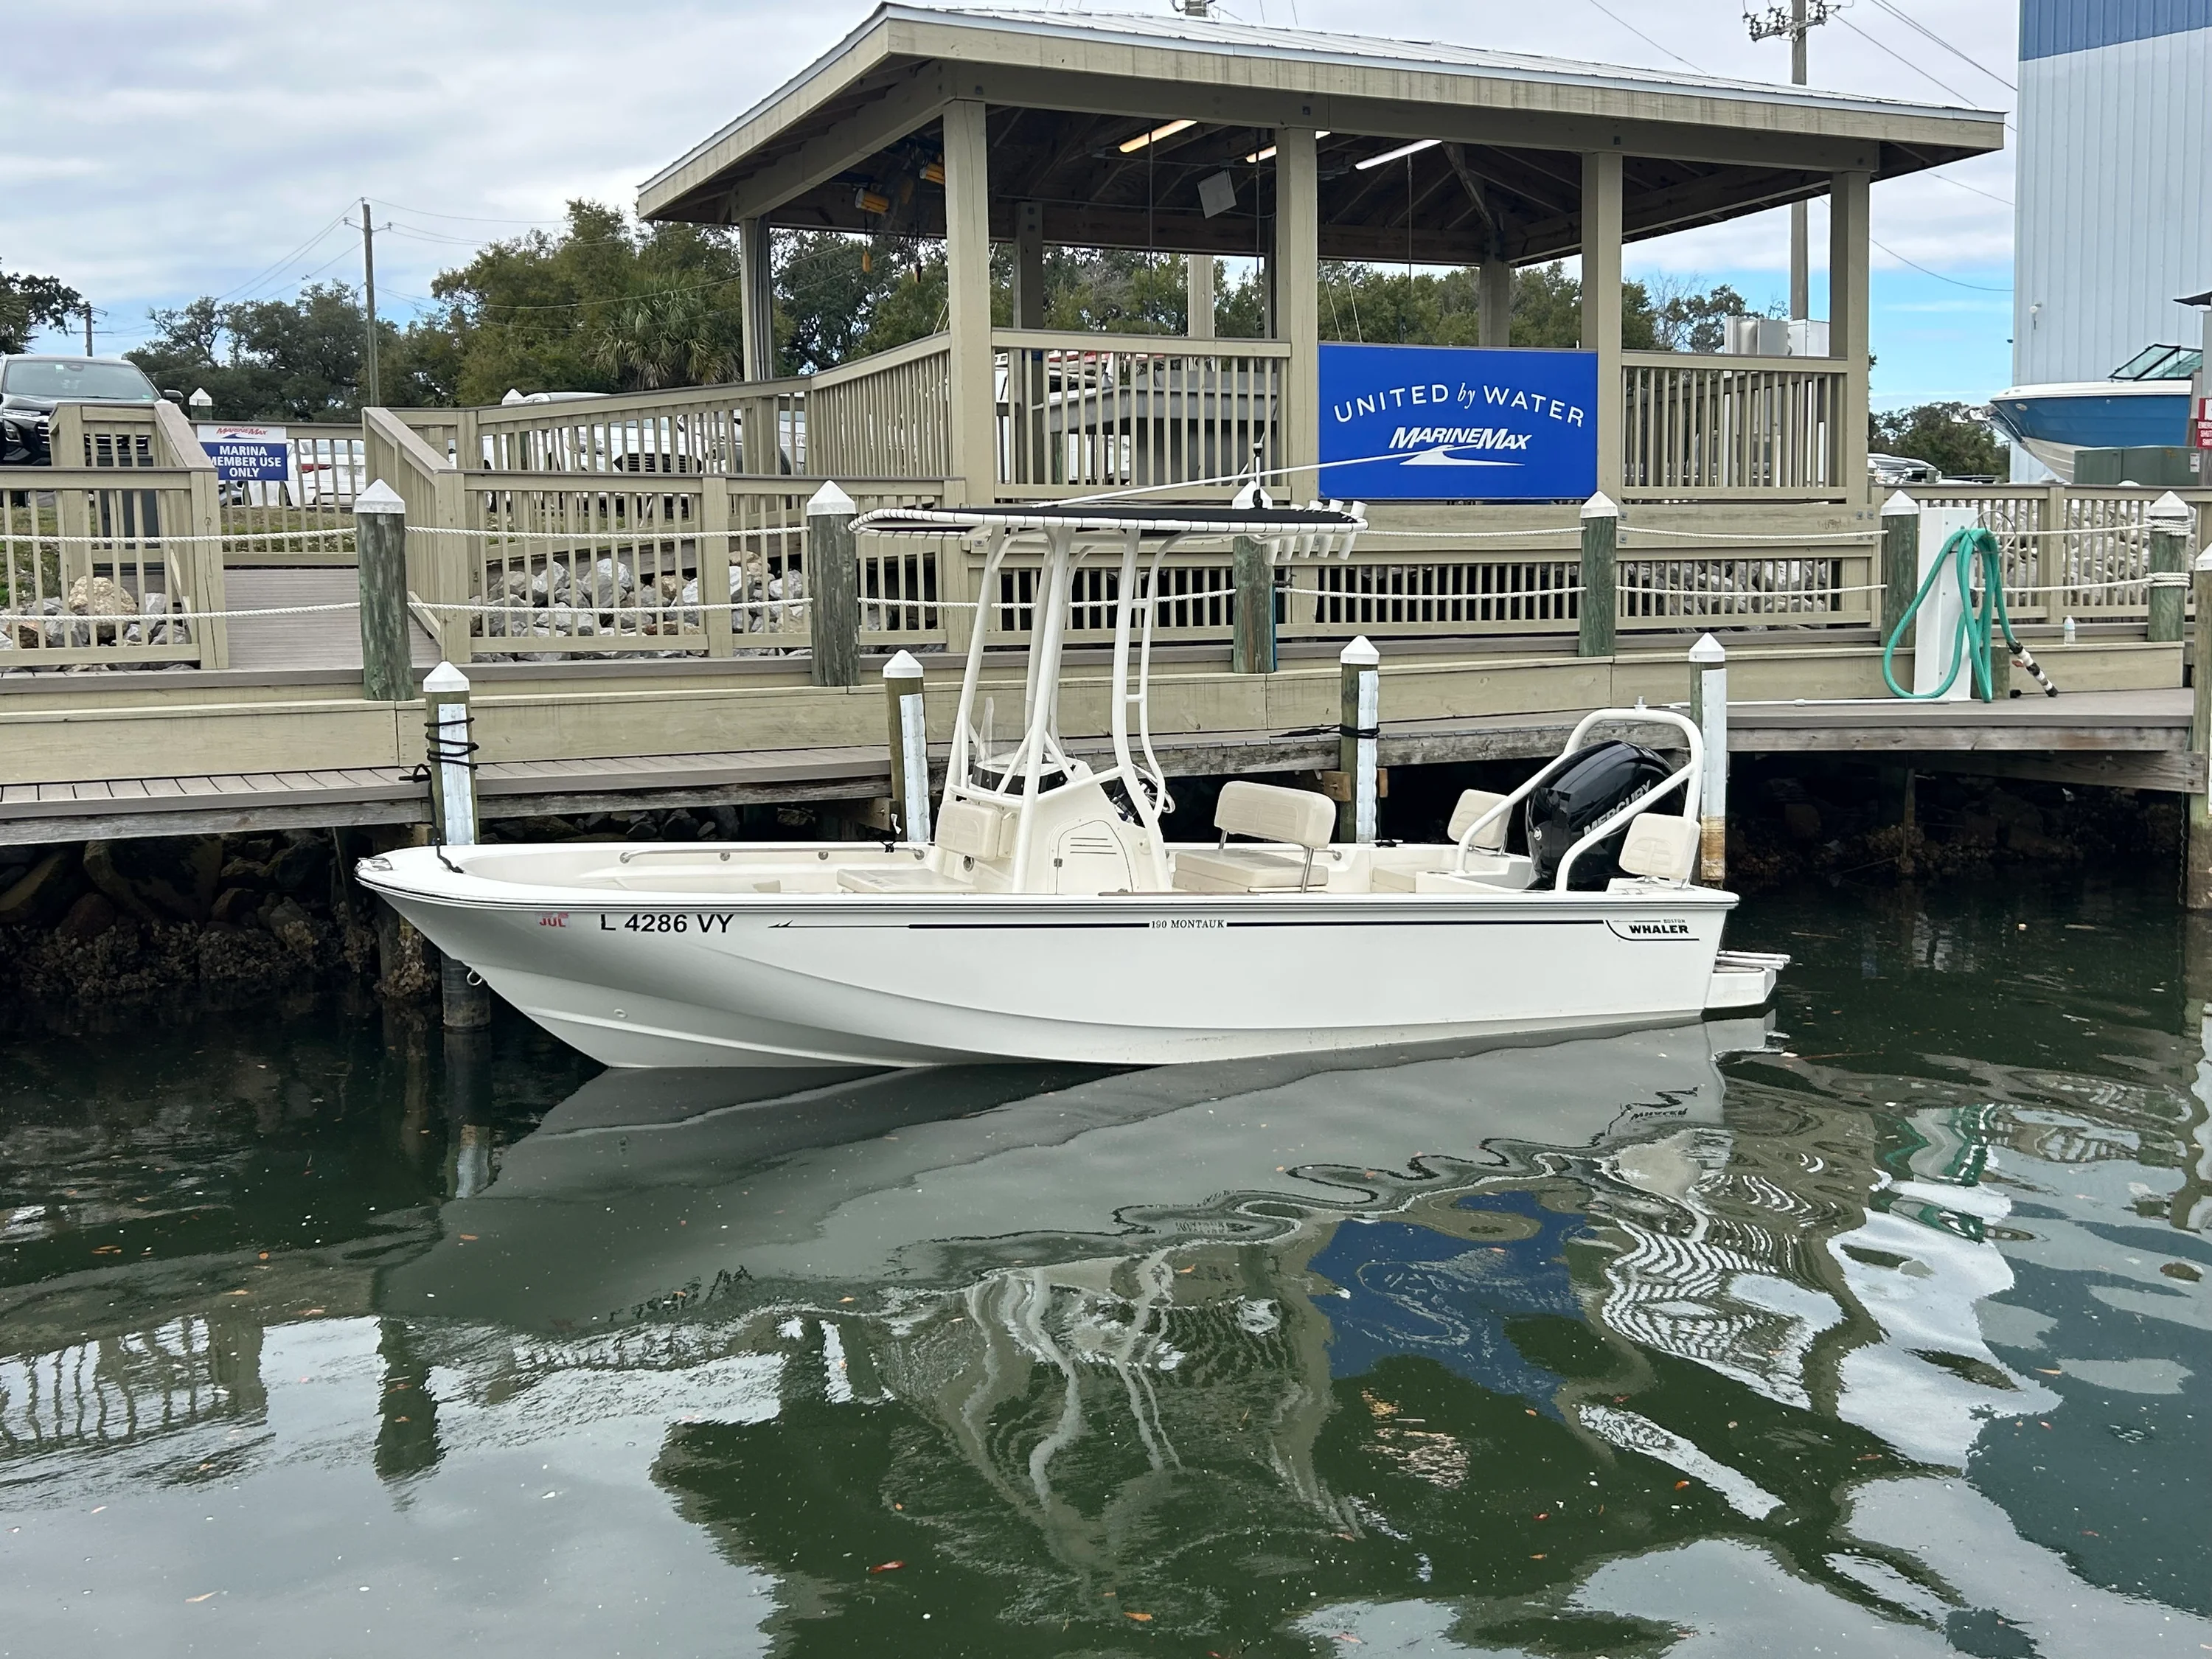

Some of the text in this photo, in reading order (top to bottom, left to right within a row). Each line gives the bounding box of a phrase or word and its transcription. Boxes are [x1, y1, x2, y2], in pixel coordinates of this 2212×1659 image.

[1333, 383, 1585, 427] UNITED by WATER
[219, 445, 267, 456] MARINA
[260, 457, 282, 467] USE
[229, 467, 260, 477] ONLY
[539, 917, 566, 927] JUL
[600, 914, 734, 933] L 4286 VY
[1151, 919, 1225, 929] 190 MONTAUK
[1629, 925, 1689, 934] WHALER
